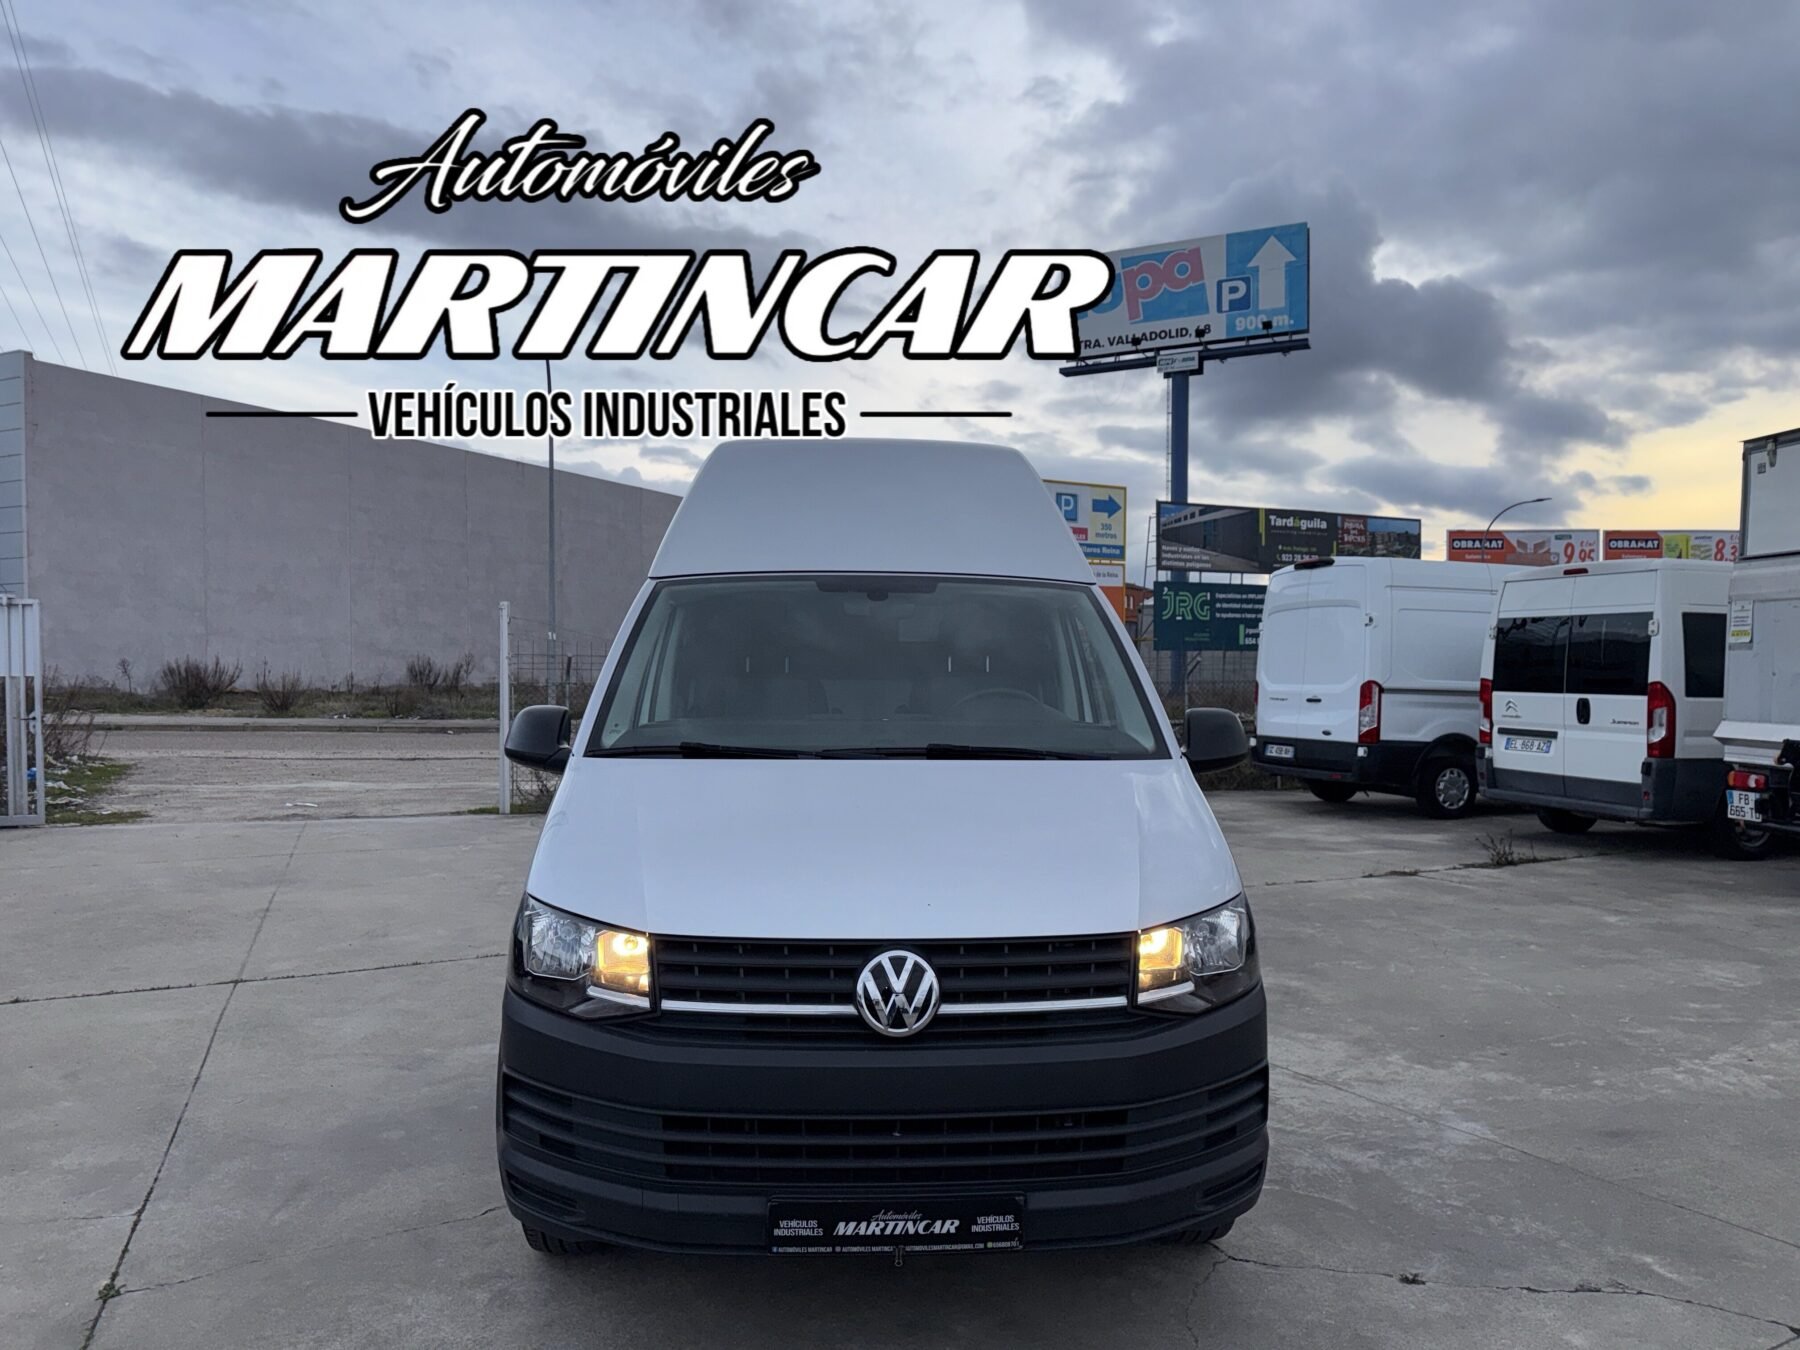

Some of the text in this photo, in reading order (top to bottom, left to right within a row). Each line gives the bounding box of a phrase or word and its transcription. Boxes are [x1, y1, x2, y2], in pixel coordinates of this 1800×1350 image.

[1086, 247, 1205, 321] upa
[1080, 338, 1105, 350] TRA.
[1269, 515, 1328, 530] Tardáguila
[1453, 540, 1503, 549] OBRAMAT
[1609, 540, 1659, 549] OBRAMAT
[779, 1219, 818, 1228] VEHÍCULOS
[977, 1214, 1015, 1224] VEHÍCULOS
[833, 1219, 960, 1235] MARTINCAR
[971, 1222, 1020, 1233] INDUSTRIALES
[773, 1228, 824, 1237] INDUSTRIALES
